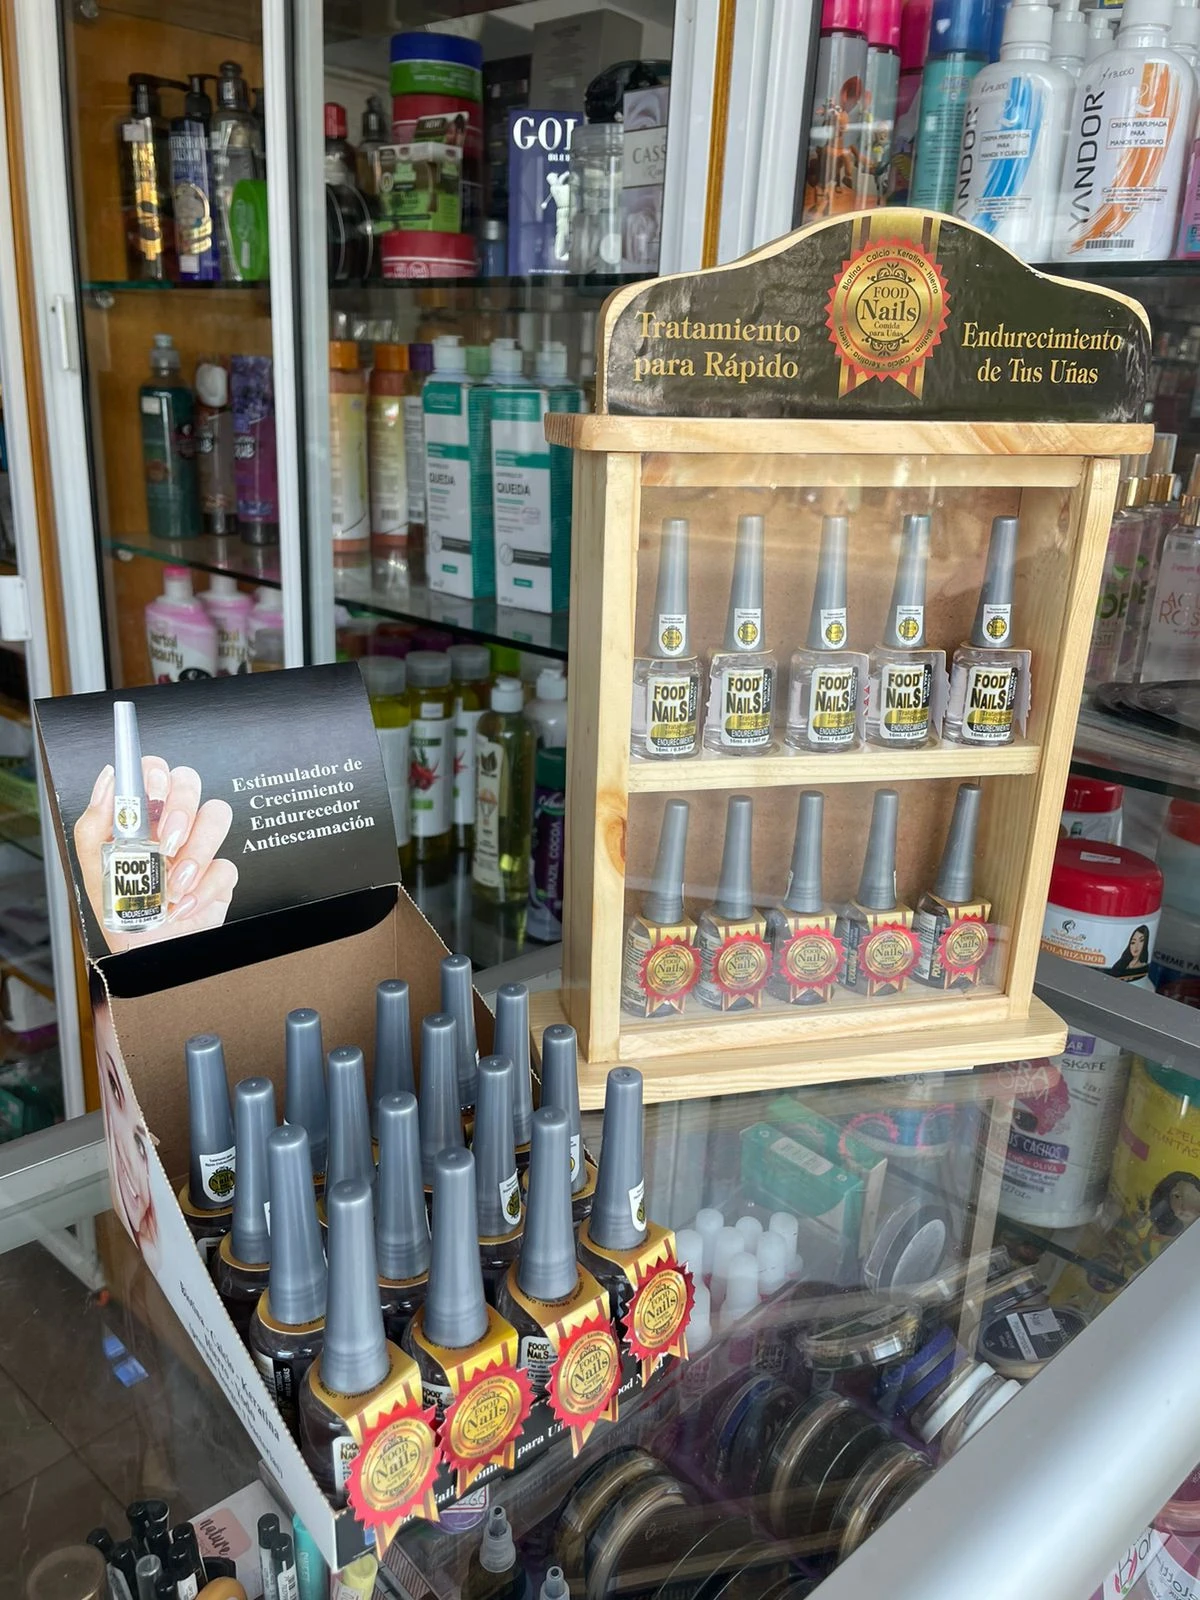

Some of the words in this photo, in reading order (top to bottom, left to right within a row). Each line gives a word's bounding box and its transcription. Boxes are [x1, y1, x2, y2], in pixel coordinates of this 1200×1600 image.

[632, 145, 668, 164] CASS
[956, 106, 979, 219] ANDOR
[1067, 90, 1105, 232] YANDOR
[842, 265, 862, 291] Biotina
[865, 249, 891, 263] Calcio
[896, 248, 925, 269] Keratina
[926, 271, 939, 295] Hierro
[873, 286, 910, 299] FOOD
[860, 299, 918, 322] Nails
[634, 310, 801, 343] Tratamiento
[873, 321, 901, 330] Comida
[961, 321, 1123, 351] Endurecimiento
[632, 356, 696, 382] para
[703, 351, 799, 384] Rápido
[977, 357, 1002, 383] de
[1008, 357, 1044, 383] Tus
[1050, 359, 1099, 384] Uñas
[429, 473, 456, 486] QUEDA
[496, 482, 531, 496] QUEDA
[728, 677, 760, 692] FOOD
[818, 676, 849, 691] FOOD
[888, 673, 920, 687] FOOD
[974, 673, 1007, 688] FOOD
[654, 685, 686, 700] FOOD
[231, 762, 340, 793] Estimulador
[343, 758, 364, 773] de
[249, 780, 354, 810] Crecimiento
[250, 799, 361, 832] Endurecedor
[242, 814, 376, 854] Antiescamación
[114, 860, 148, 875] FOOD
[874, 948, 903, 958] Nails
[954, 940, 979, 950] Nails
[1041, 942, 1106, 964] POLARIZADOR
[657, 962, 685, 974] Nails
[1154, 950, 1184, 967] CREME
[1187, 961, 1200, 972] PA
[1067, 1040, 1085, 1050] AR
[1061, 1057, 1107, 1072] SKAFE
[1023, 1139, 1061, 1160] CACHOS
[1032, 1161, 1058, 1172] OLIVA
[647, 1296, 677, 1320] Nails
[651, 1290, 671, 1310] FOOD
[527, 1350, 549, 1360] NAILS
[528, 1342, 547, 1351] FOOD
[578, 1351, 602, 1370] FOOD
[572, 1357, 609, 1388] Nails
[240, 1376, 280, 1443] Keratina
[474, 1398, 500, 1418] FOOD
[516, 1433, 545, 1459] para
[547, 1421, 566, 1438] Uñ
[617, 1378, 634, 1396] ood
[466, 1404, 507, 1434] Nails
[383, 1442, 409, 1465] FOOD
[376, 1449, 418, 1484] Nails
[200, 1517, 231, 1556] nature
